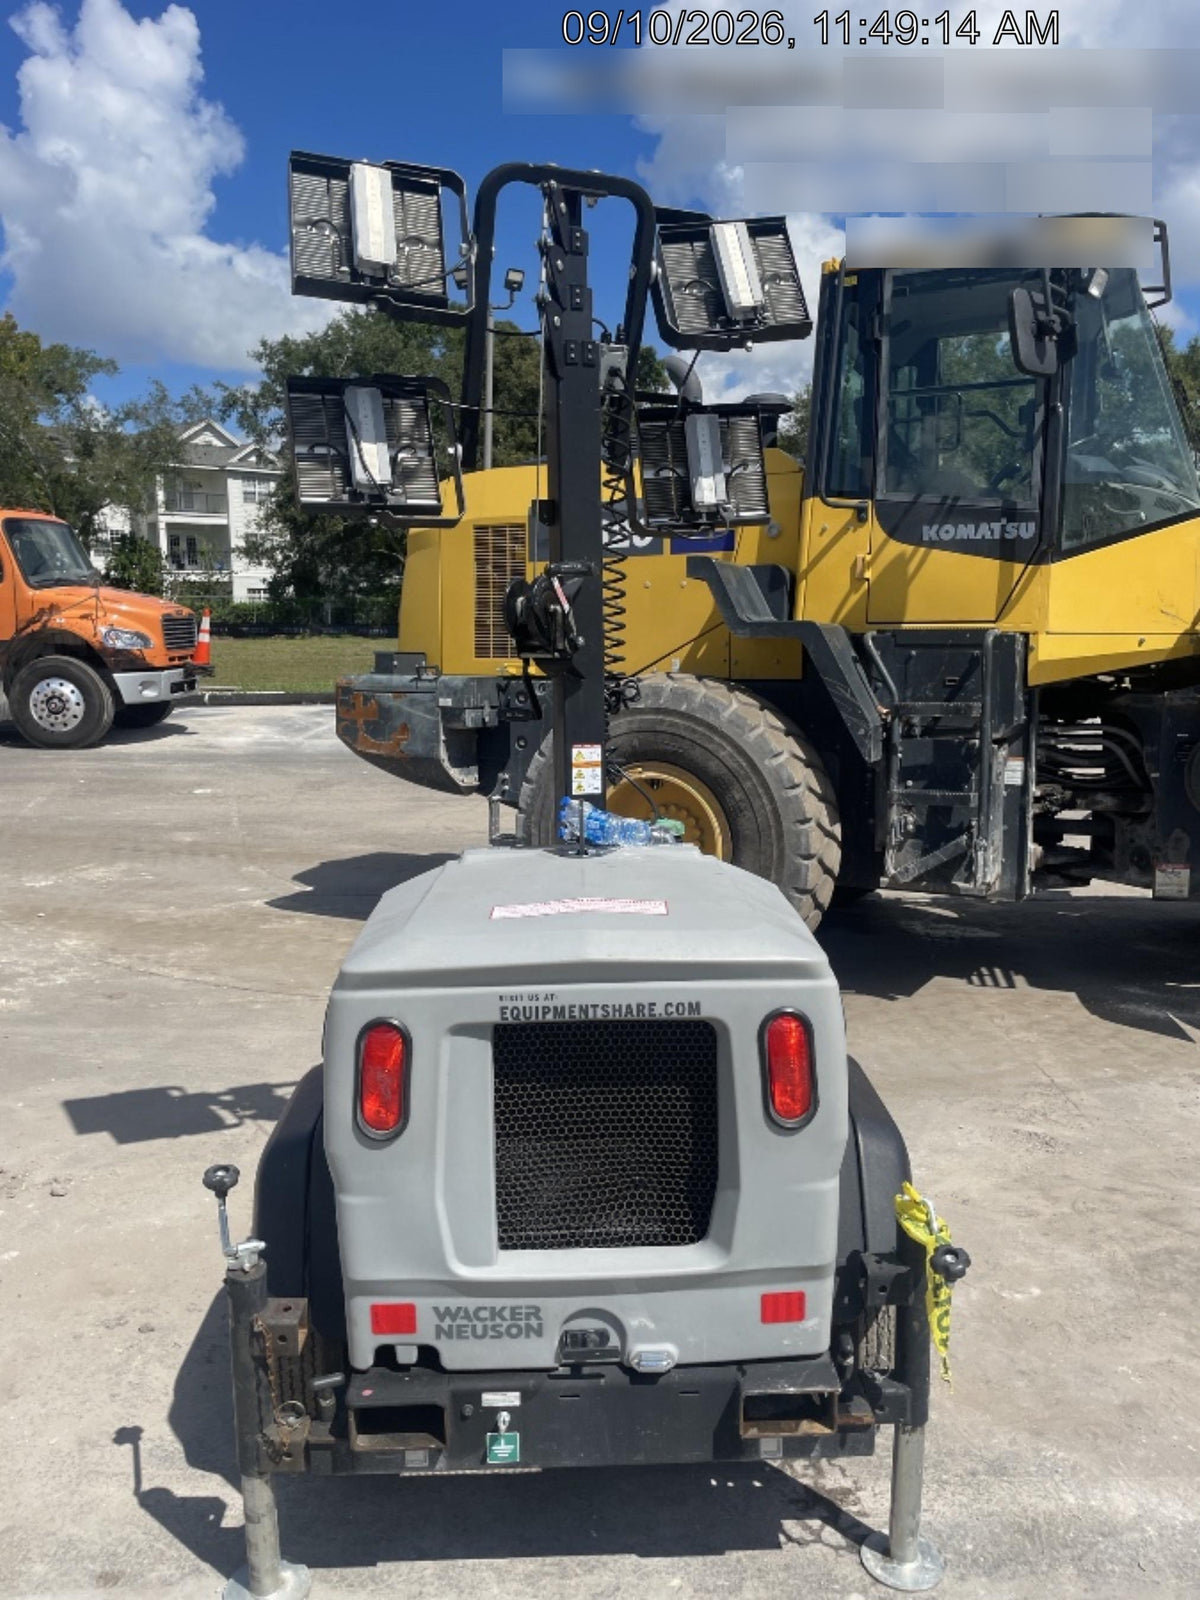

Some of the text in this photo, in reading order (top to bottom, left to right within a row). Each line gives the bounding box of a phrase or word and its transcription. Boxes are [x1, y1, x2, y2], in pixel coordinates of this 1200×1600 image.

[922, 518, 1036, 541] KOMATSU
[499, 1001, 702, 1022] EQUIPMENTSHARE.COM
[432, 1305, 543, 1323] WACKER
[435, 1322, 543, 1340] NEUSON
